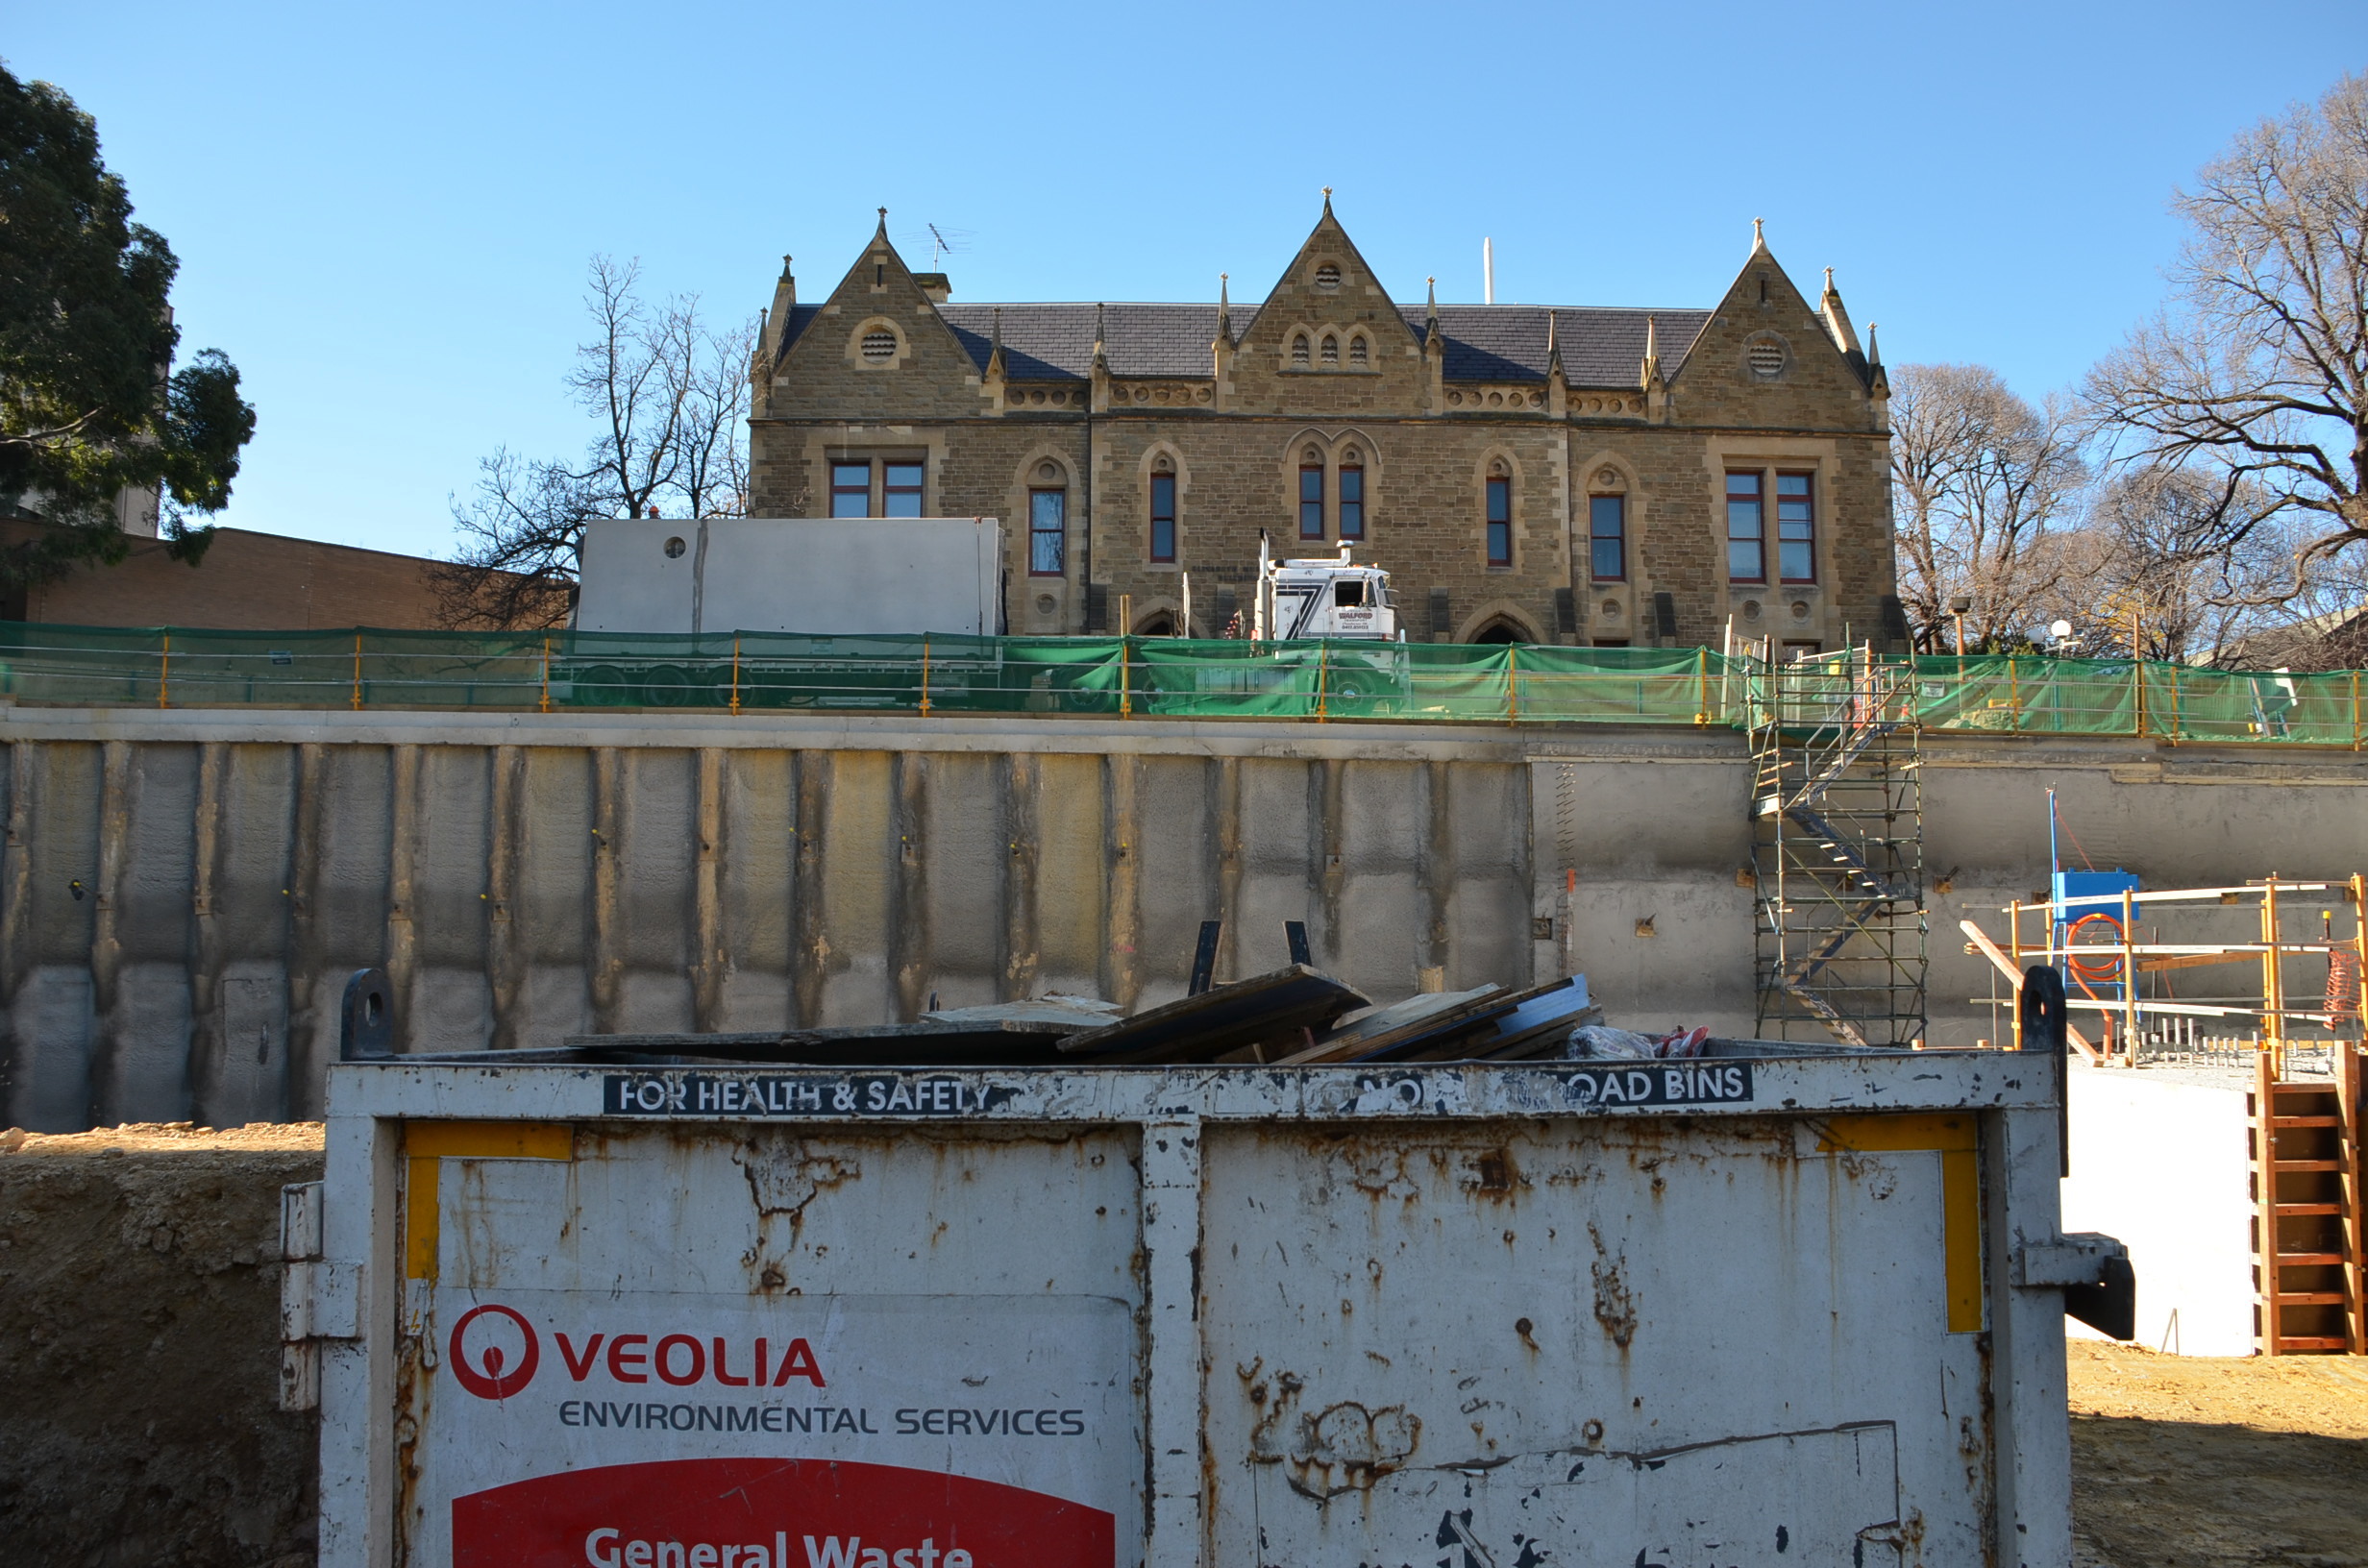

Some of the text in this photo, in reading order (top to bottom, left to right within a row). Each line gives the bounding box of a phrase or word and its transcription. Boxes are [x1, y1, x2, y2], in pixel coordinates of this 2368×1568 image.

[620, 1081, 687, 1111] FOR
[699, 1081, 823, 1111] HEALTH
[832, 1082, 857, 1111] &
[867, 1081, 991, 1111] SAFETY
[1566, 1071, 1653, 1103] OAD
[1665, 1066, 1744, 1100] BINS
[554, 1332, 827, 1387] VEOLIA
[558, 1400, 1086, 1436] ENVIRONMENTAL SERVICES
[584, 1527, 973, 1568] General Waste
